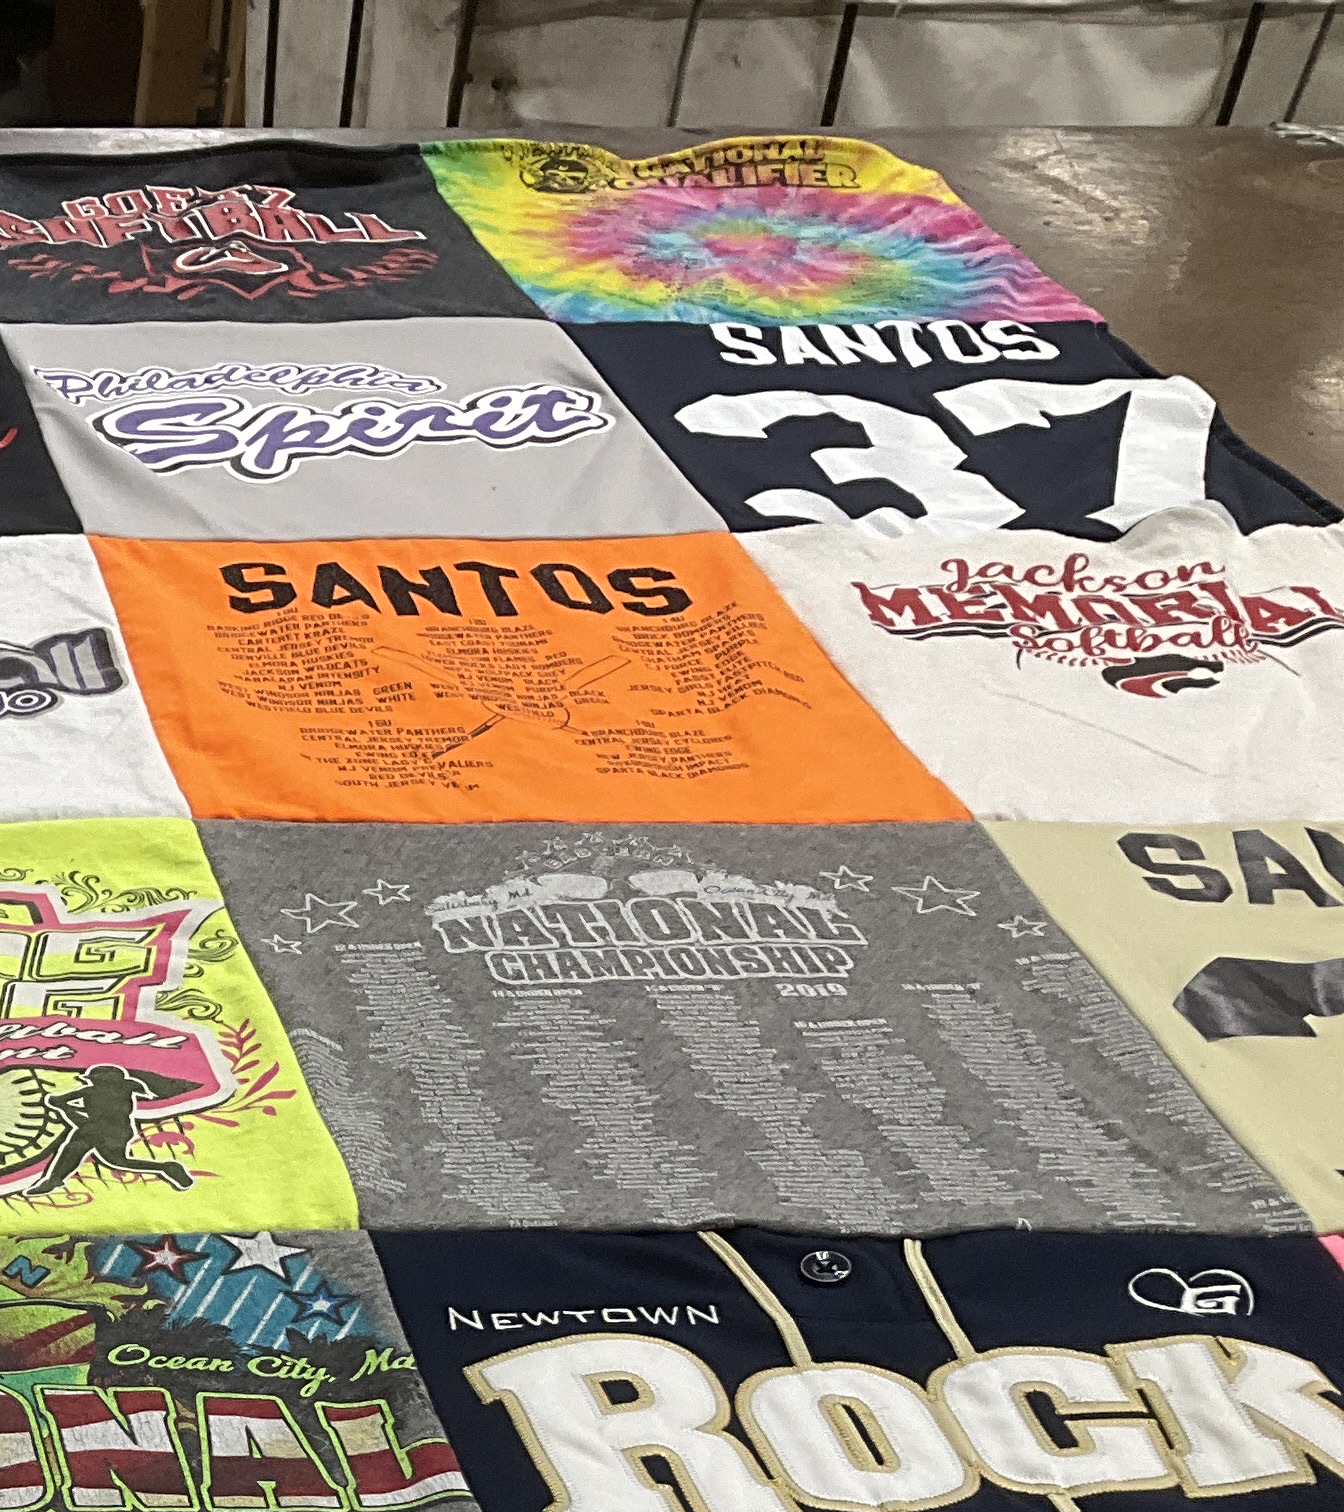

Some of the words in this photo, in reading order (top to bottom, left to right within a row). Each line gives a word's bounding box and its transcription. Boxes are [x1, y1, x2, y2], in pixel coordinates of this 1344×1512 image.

[709, 321, 1063, 368] SANTOS
[30, 363, 448, 403] Philadelphia
[91, 384, 611, 484] Spirit
[673, 374, 1218, 538] 37
[219, 561, 694, 617] SANTOS
[939, 552, 1226, 593] Jackson
[1009, 613, 1258, 656] Softball
[432, 897, 870, 954] NATIONAL
[484, 945, 855, 985] CHAMPIONSHIP
[775, 983, 849, 998] 2019
[447, 1303, 721, 1333] NEWTOWN
[106, 1342, 235, 1378] Ocean
